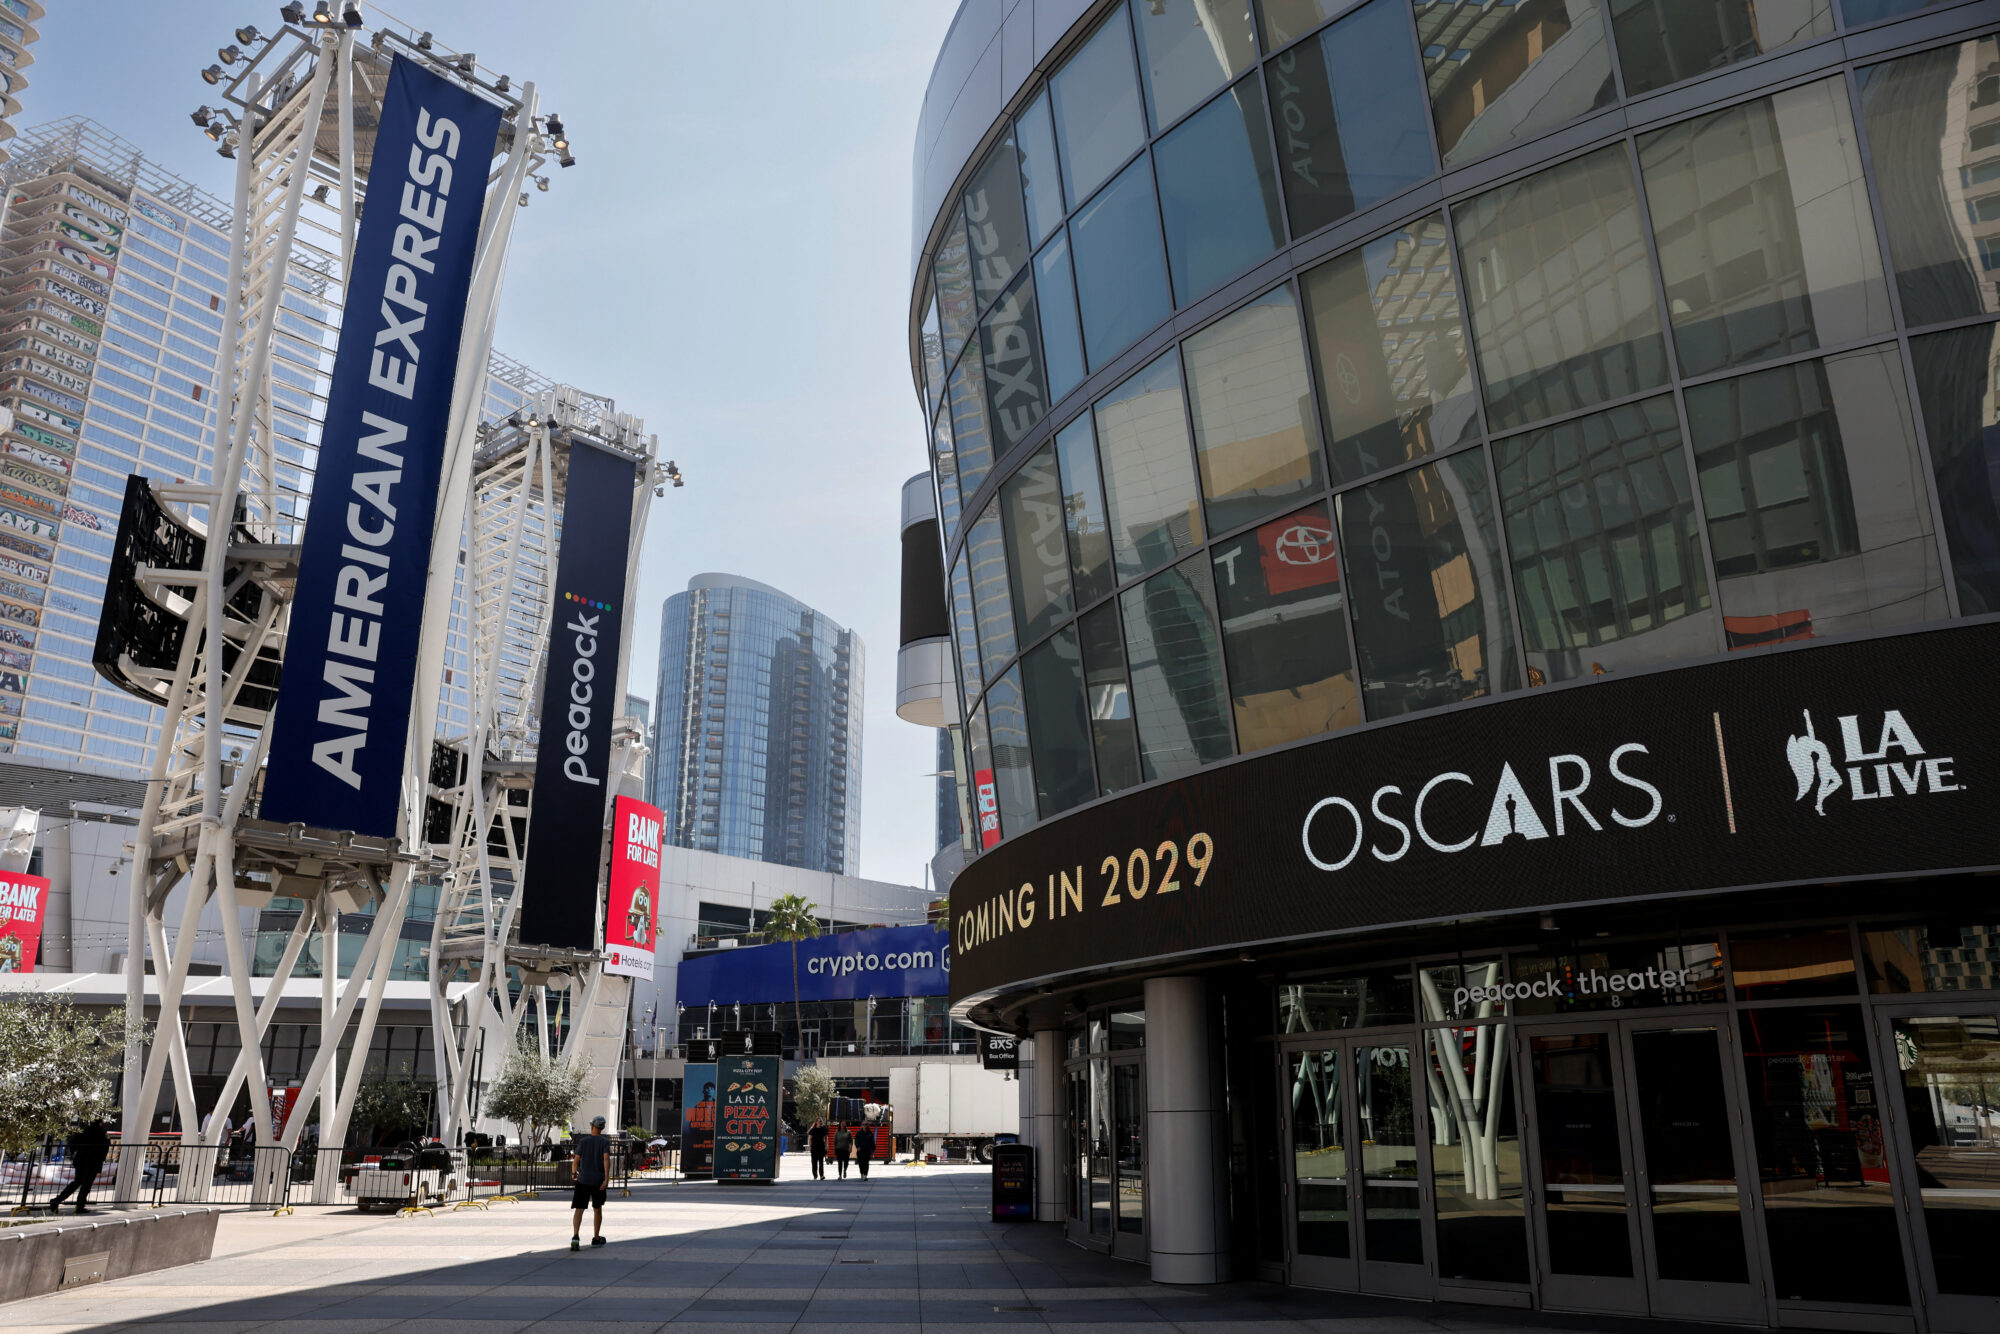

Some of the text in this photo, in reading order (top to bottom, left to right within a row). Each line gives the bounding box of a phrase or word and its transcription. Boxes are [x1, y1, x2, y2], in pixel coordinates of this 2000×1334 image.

[311, 106, 461, 790] AMERICAN EXPRESS
[563, 610, 600, 786] peacock
[1837, 709, 1926, 762] LA
[1847, 757, 1959, 801] LIVE
[1302, 742, 1662, 872] OSCARS
[628, 812, 660, 851] BANK
[627, 844, 659, 868] FOR LATER
[0, 882, 40, 909] BANK
[957, 832, 1214, 955] COMING IN 2029
[13, 907, 36, 922] LATER
[807, 951, 934, 977] crypto.com
[1454, 965, 1691, 1015] peacock theater
[1610, 995, 1621, 1008] 8
[1341, 1015, 1348, 1027] 7
[989, 1039, 1014, 1050] axs
[724, 1105, 770, 1119] PIZZA
[729, 1095, 766, 1104] LA IS A
[726, 1120, 767, 1134] CITY
